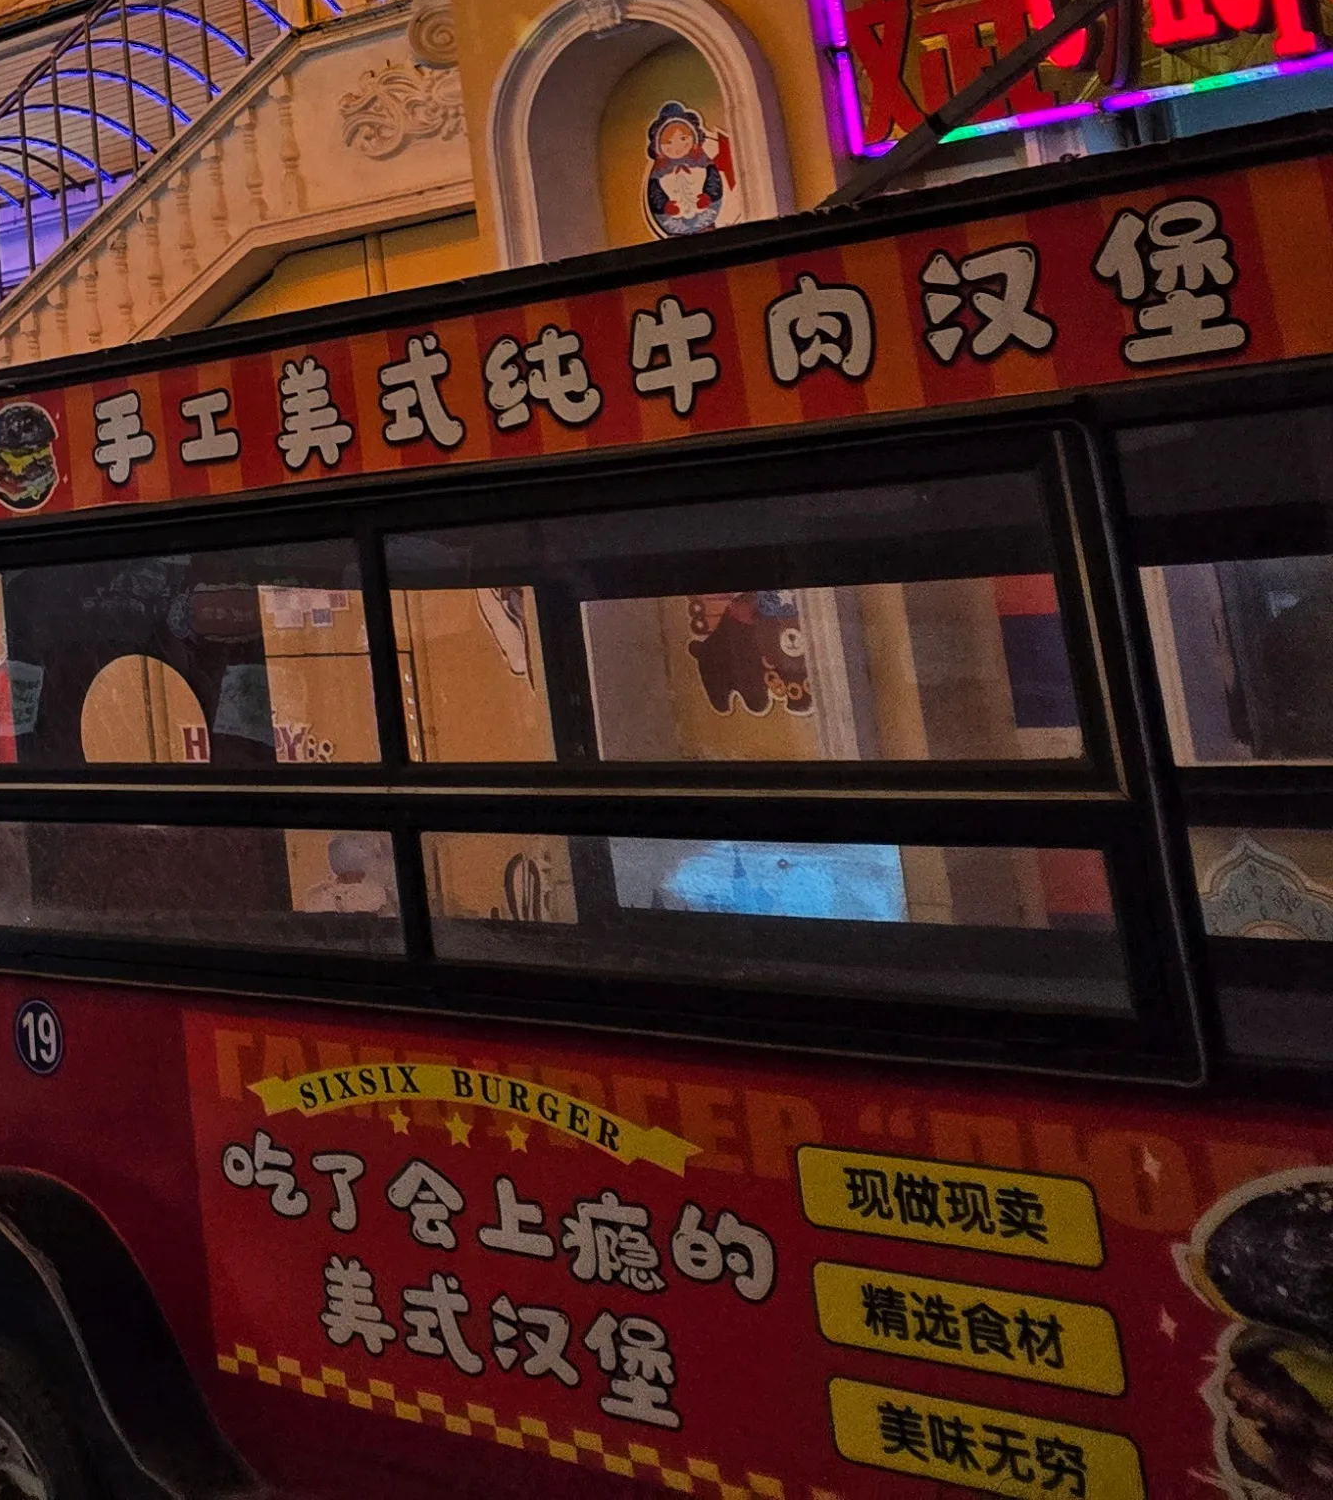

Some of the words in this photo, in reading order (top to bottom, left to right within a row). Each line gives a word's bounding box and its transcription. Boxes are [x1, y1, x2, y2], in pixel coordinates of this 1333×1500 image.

[91, 196, 1249, 486] 手工美式纯牛肉汉堡
[20, 1010, 57, 1063] 19
[298, 1065, 420, 1111] SIXSIX
[452, 1071, 621, 1153] BURGER
[221, 1129, 775, 1302] 吃了会上瘾的
[843, 1165, 1050, 1246] 现做现卖
[319, 1255, 683, 1431] 美式汉堡
[860, 1282, 1065, 1371] 精选食材
[877, 1400, 1088, 1499] 美味无穷
